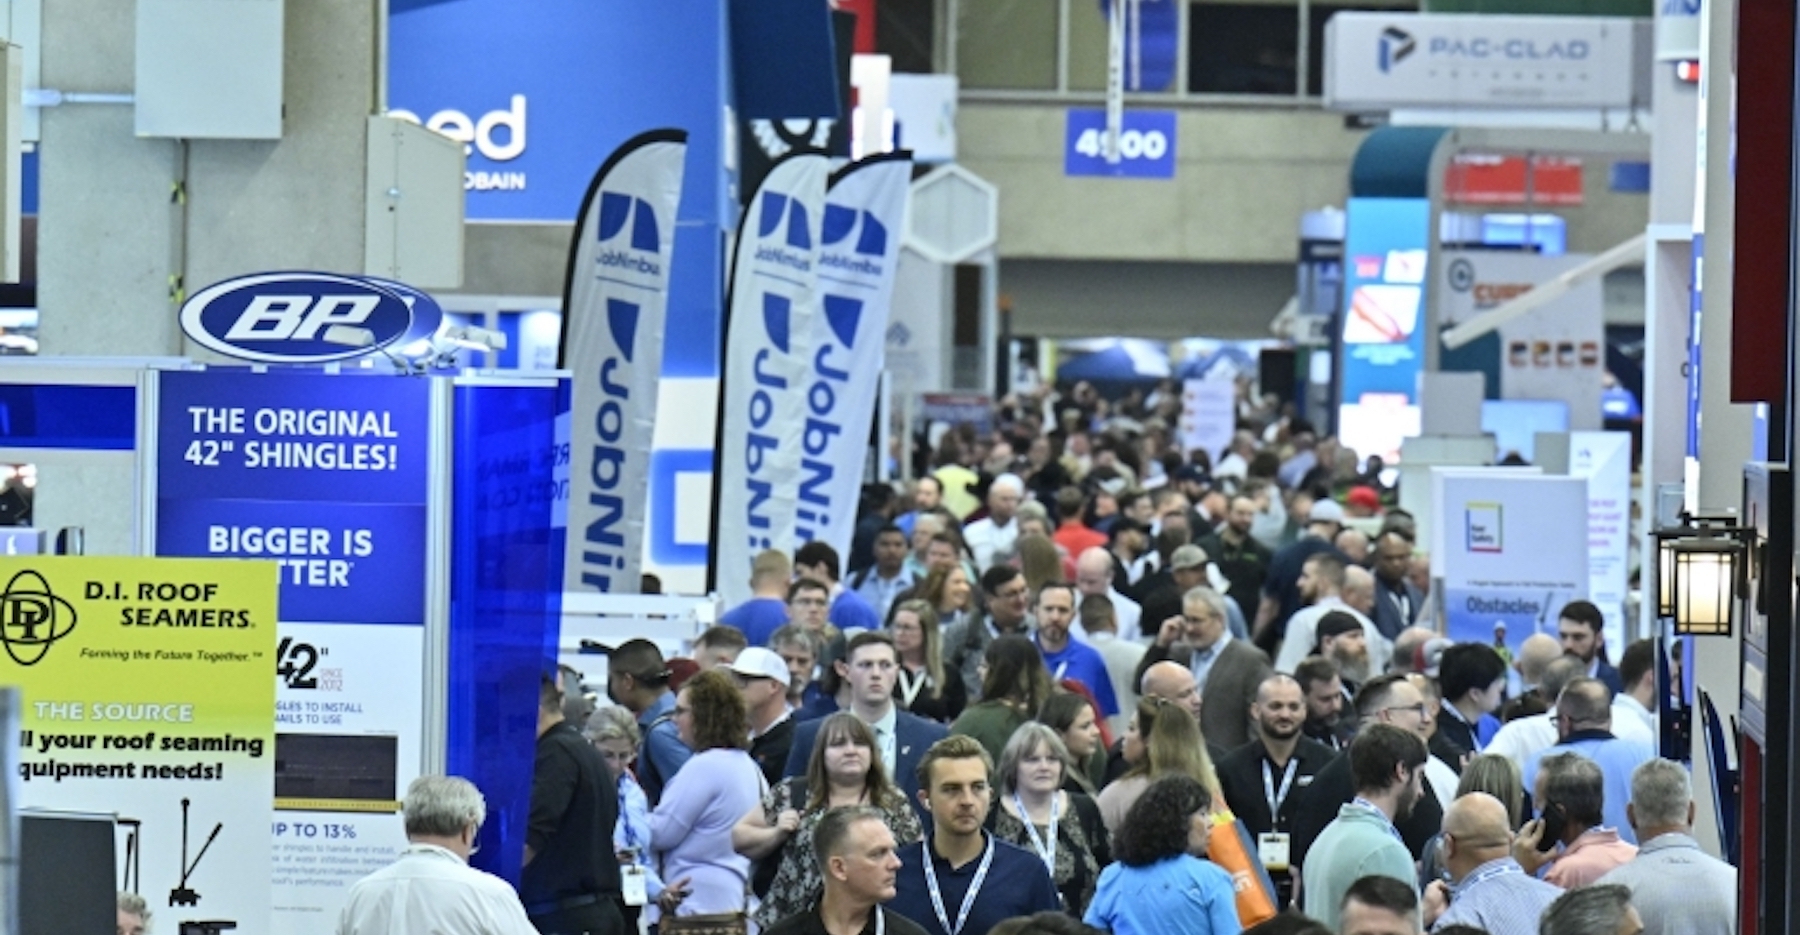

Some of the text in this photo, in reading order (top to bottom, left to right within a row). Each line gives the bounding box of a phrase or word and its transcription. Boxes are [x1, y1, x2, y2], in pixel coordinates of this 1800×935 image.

[1430, 37, 1589, 60] PAC-CLAD
[387, 93, 526, 161] ed
[224, 295, 381, 340] BP
[188, 406, 398, 438] THE ORIGINAL
[184, 440, 398, 471] 42" SHINGLES!
[745, 347, 788, 568] JobNi
[209, 525, 373, 556] BIGGER IS
[85, 581, 218, 602] D.I. ROOF
[1467, 595, 1539, 614] Obstacles
[80, 648, 130, 661] Forming
[133, 649, 151, 660] the
[155, 650, 193, 661] Future
[34, 701, 194, 723] THE SOURCE
[306, 702, 319, 713] TO
[321, 702, 363, 714] INSTALL
[306, 714, 319, 724] TO
[322, 714, 342, 725] USE
[38, 734, 97, 754] your
[103, 731, 156, 751] roof
[160, 733, 264, 758] seaming
[141, 762, 224, 780] needs!
[293, 823, 317, 838] TO
[323, 824, 357, 839] 13%
